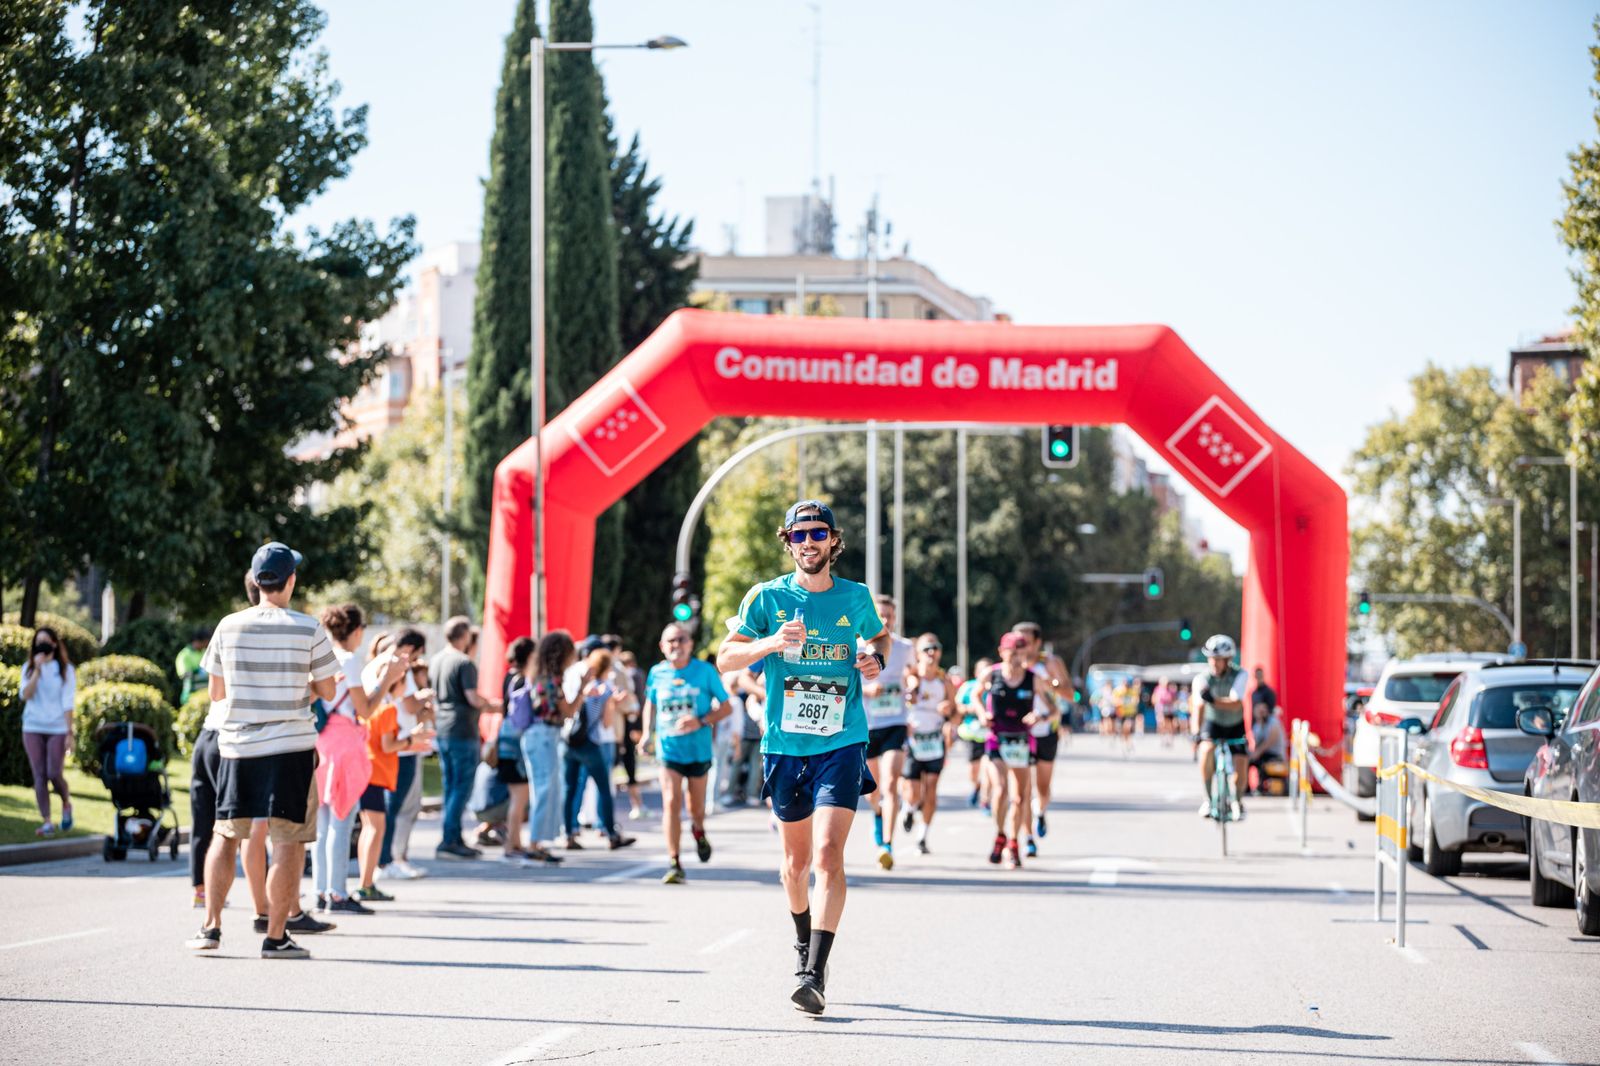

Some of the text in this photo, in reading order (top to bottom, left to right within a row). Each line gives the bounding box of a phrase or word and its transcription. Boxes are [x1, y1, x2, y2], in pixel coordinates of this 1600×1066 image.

[714, 347, 1118, 391] Comunidad de Madrid
[804, 693, 826, 701] NANDEZ
[797, 702, 829, 719] 2687
